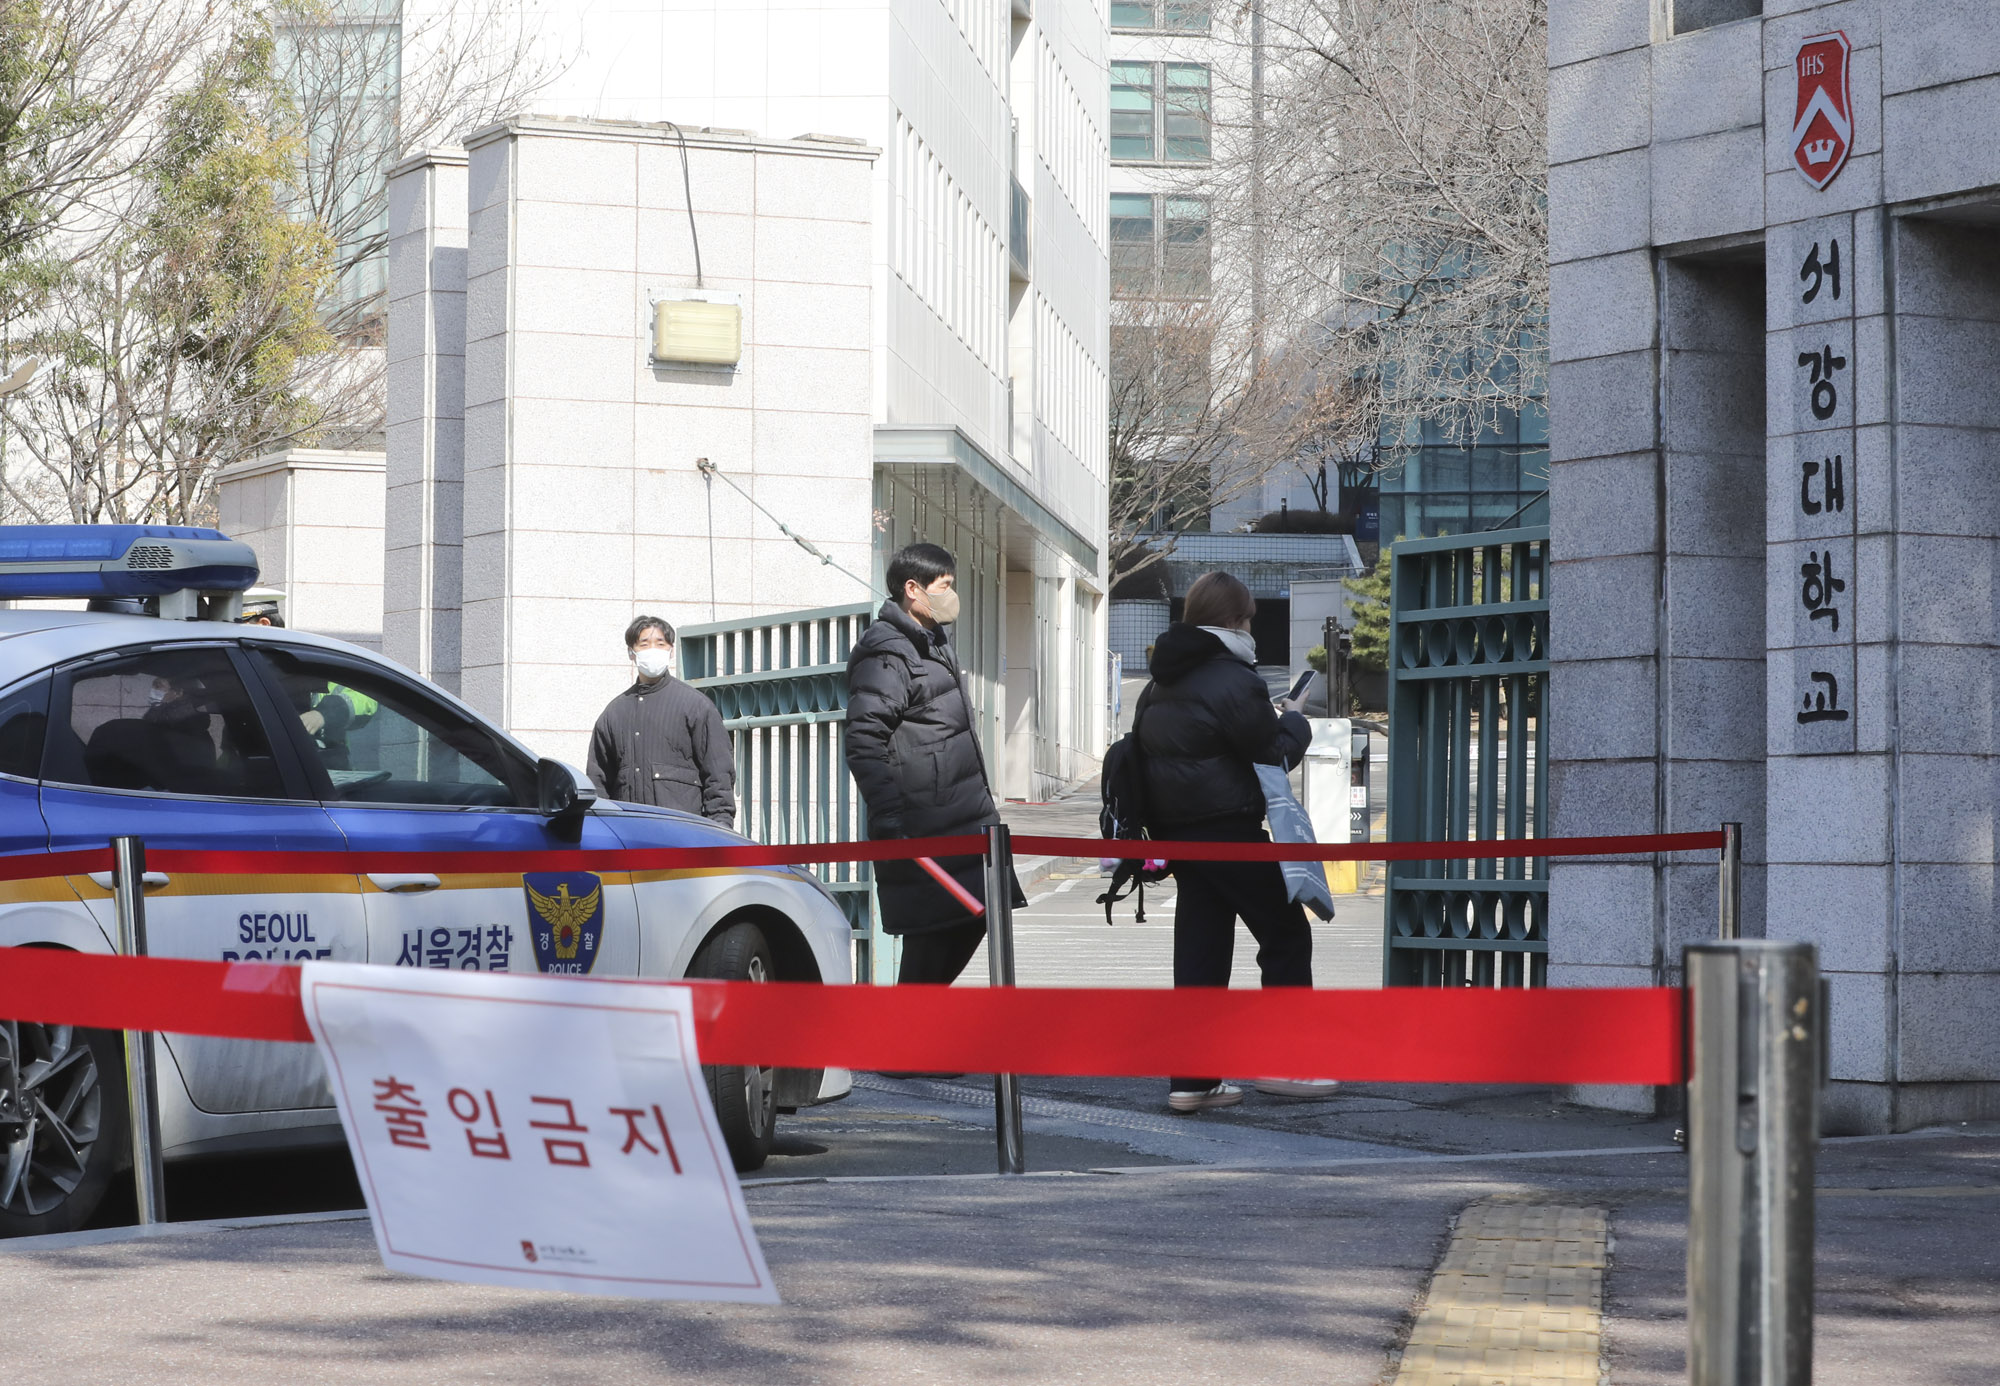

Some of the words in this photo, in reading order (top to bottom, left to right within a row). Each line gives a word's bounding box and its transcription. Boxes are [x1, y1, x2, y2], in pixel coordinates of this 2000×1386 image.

[1802, 53, 1825, 77] IHS
[1797, 238, 1847, 725] 서강대학교
[239, 913, 316, 943] SEOUL
[548, 962, 582, 975] POLICE
[372, 1075, 684, 1175] 출입금지
